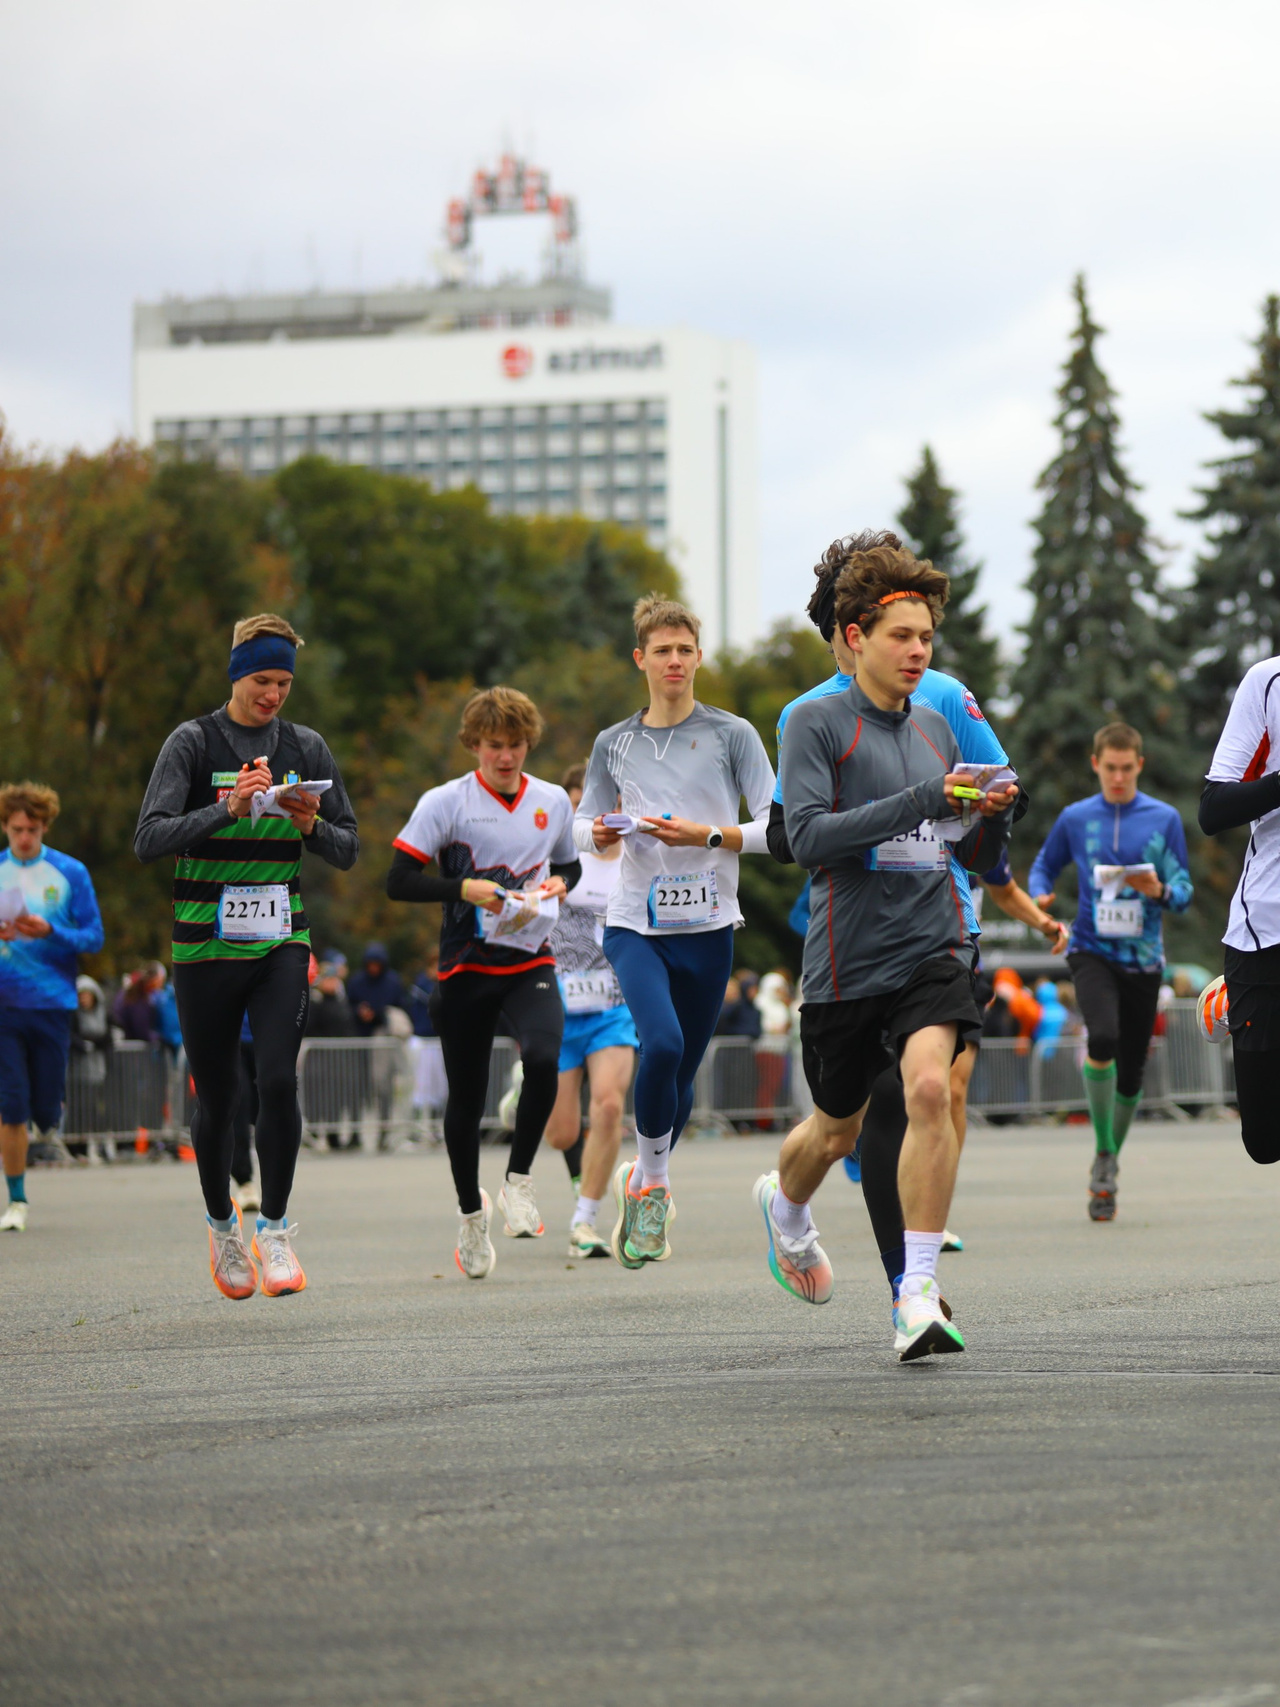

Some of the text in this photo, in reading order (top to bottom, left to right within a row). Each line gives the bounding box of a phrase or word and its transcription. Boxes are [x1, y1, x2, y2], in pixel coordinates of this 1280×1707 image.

[548, 343, 662, 372] azimut
[657, 886, 707, 906] 222.1
[225, 900, 276, 918] 227.1
[568, 981, 605, 996] 233.1
